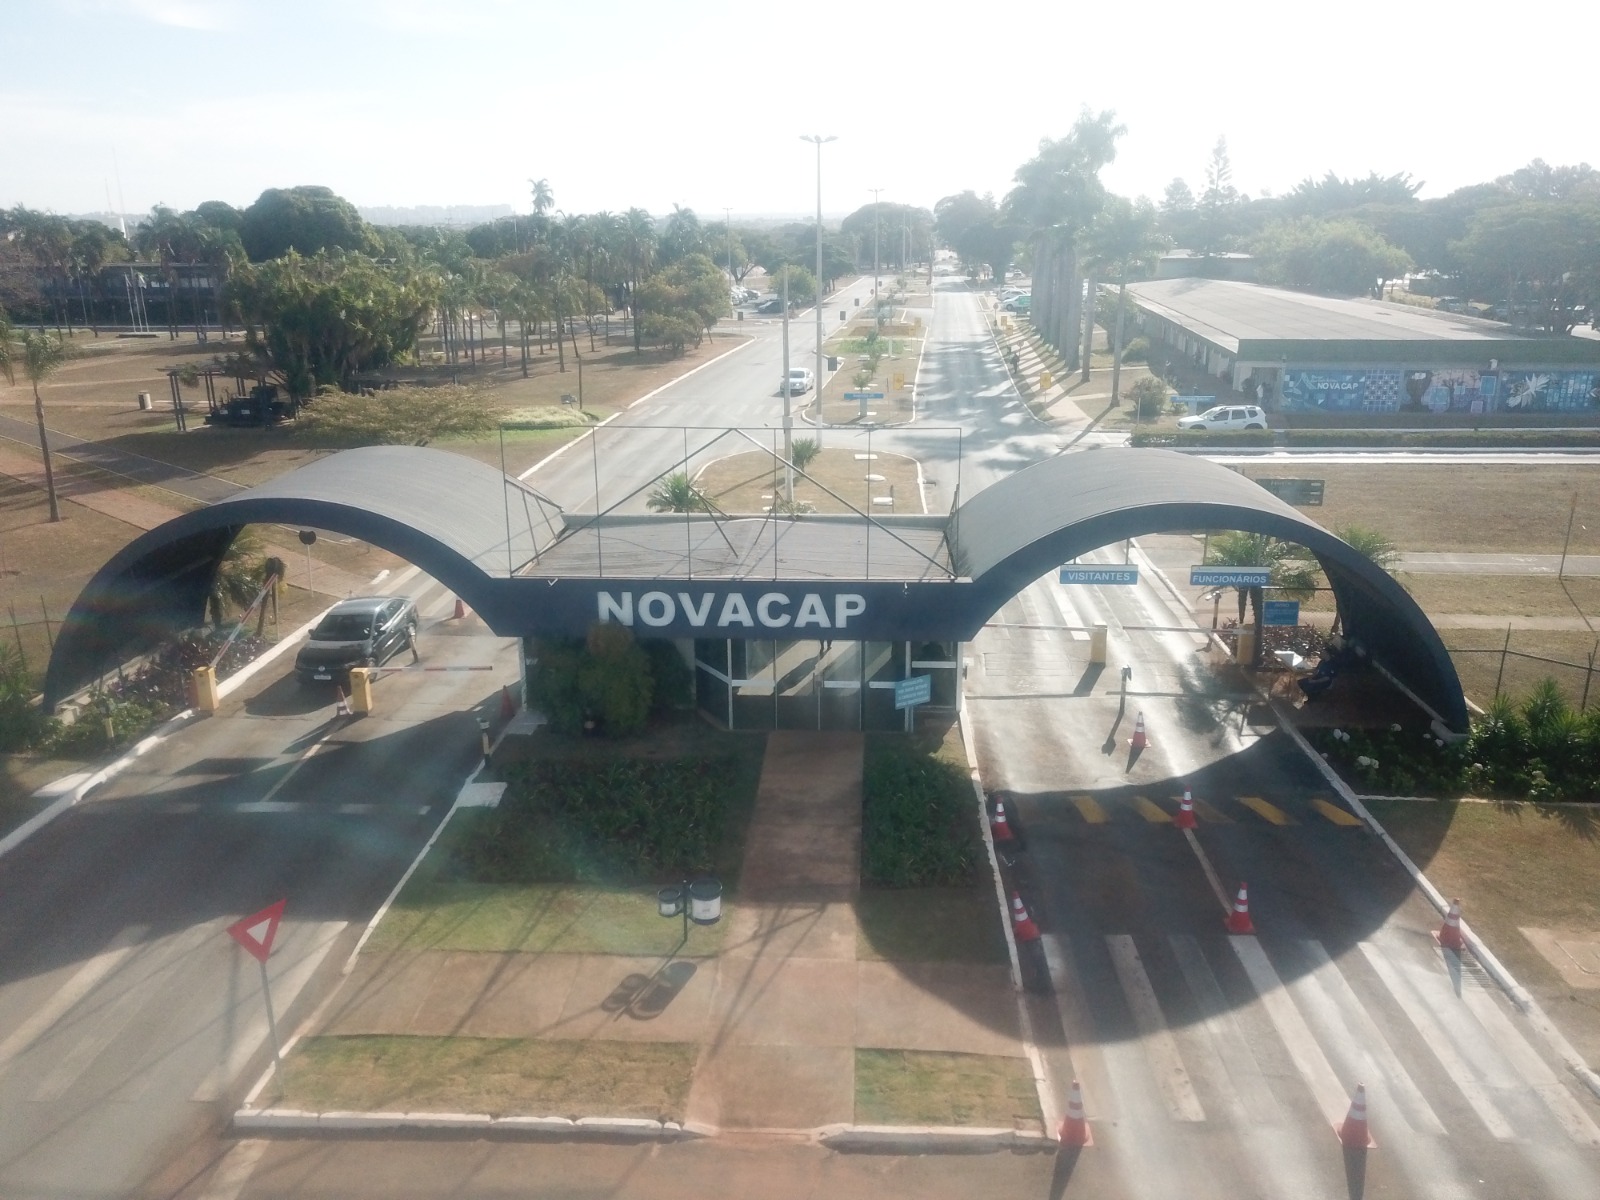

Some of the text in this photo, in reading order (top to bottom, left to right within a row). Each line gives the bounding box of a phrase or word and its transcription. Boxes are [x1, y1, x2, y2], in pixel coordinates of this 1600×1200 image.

[1317, 382, 1359, 390] NOVACAP
[1068, 571, 1131, 582] VISITANTES
[1192, 574, 1268, 584] FUNCIONÁRIOS
[597, 591, 866, 629] NOVACAP
